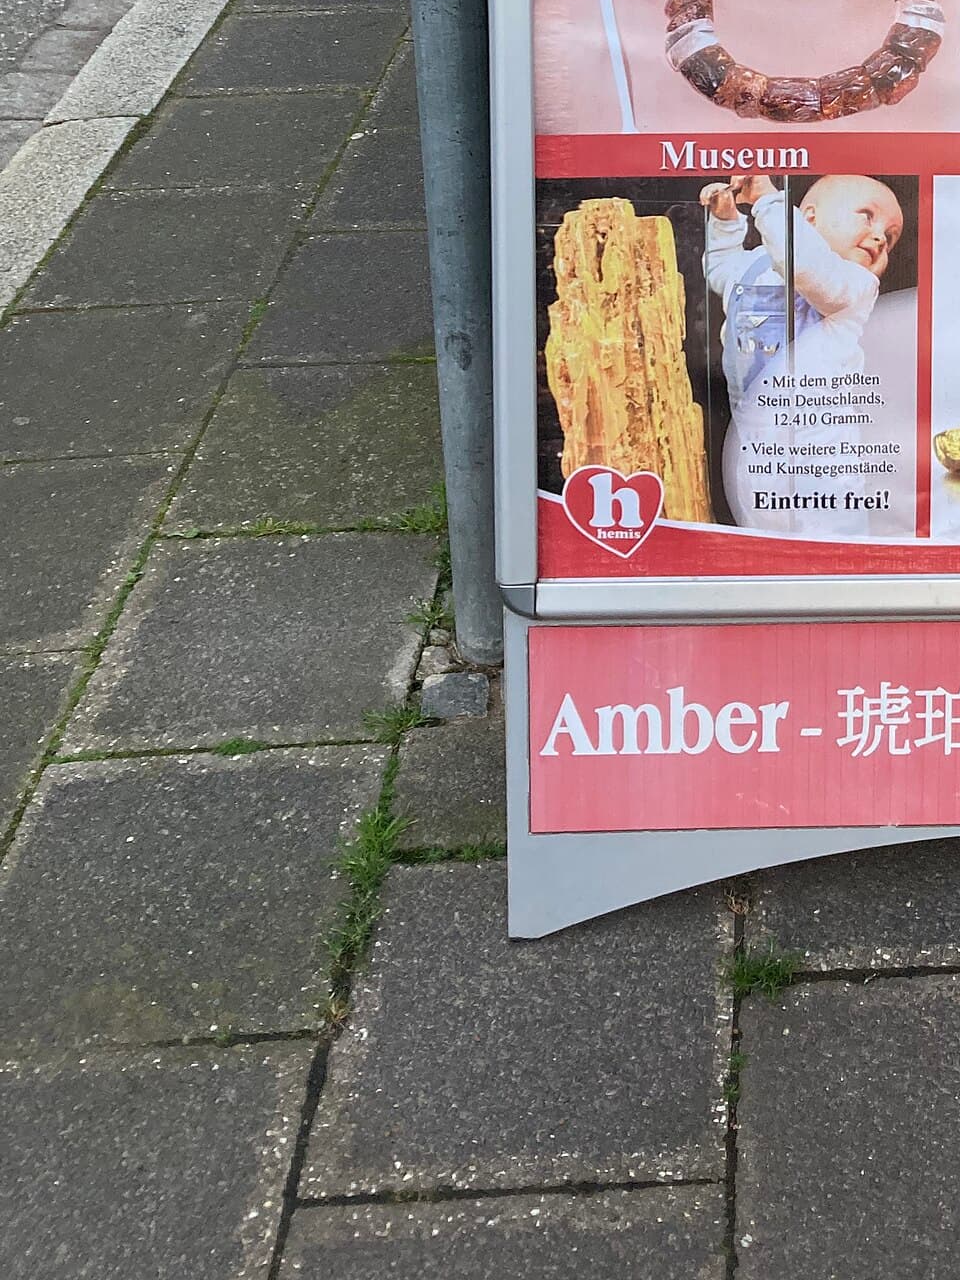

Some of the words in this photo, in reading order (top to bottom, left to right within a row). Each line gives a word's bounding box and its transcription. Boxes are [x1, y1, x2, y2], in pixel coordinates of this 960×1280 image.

[660, 141, 810, 170] Museum
[773, 376, 795, 388] Mit
[800, 375, 826, 387] dem
[832, 373, 880, 389] größten
[758, 395, 790, 406] Stein
[796, 393, 885, 407] Deutschlands,
[775, 413, 816, 425] 12.410
[821, 413, 872, 425] Gramm.
[752, 443, 784, 455] Viele
[789, 443, 835, 455] weitere
[840, 442, 900, 457] Exponate
[749, 462, 771, 473] und
[777, 461, 896, 477] Kunstgegenstände.
[588, 472, 645, 528] h
[754, 492, 837, 509] Eintritt
[845, 491, 888, 509] frei!
[597, 528, 642, 540] hemis
[540, 687, 789, 755] Amber
